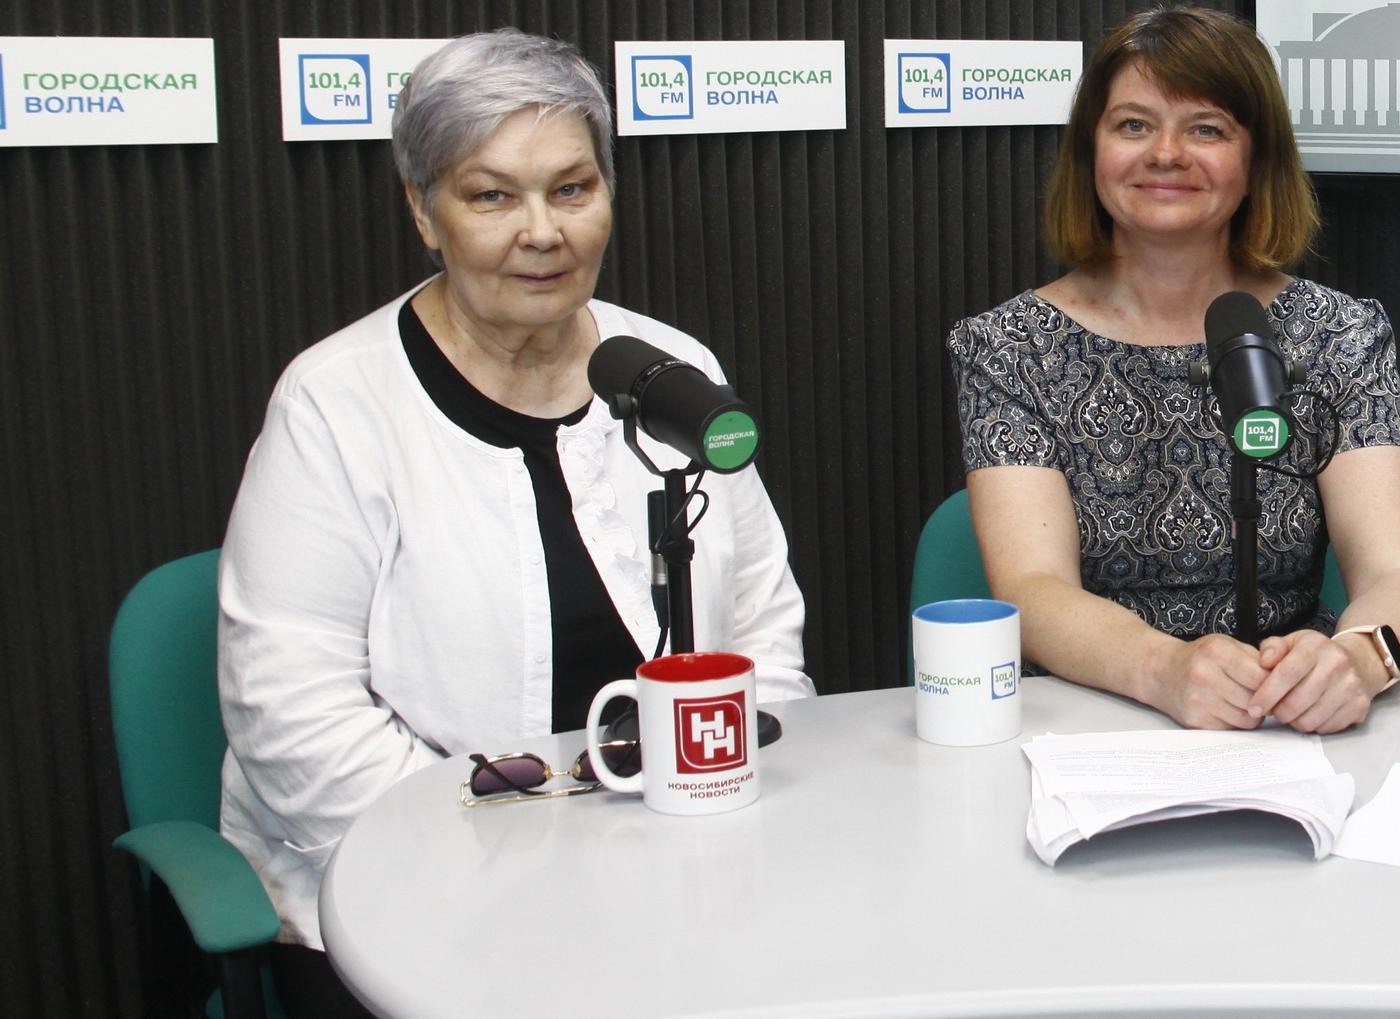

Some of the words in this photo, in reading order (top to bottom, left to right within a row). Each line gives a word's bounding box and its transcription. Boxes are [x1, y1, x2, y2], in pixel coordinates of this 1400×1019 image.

[23, 73, 197, 93] ГОРОДСКАЯ
[309, 72, 361, 91] 101,4
[640, 72, 685, 89] 101,4
[706, 70, 833, 87] ГОРОДСКАЯ
[905, 69, 944, 85] 101,4
[962, 68, 1072, 84] ГОРОДСКАЯ
[661, 92, 684, 104] FM
[706, 90, 779, 105] ВОЛНА
[922, 87, 943, 98] FM
[962, 87, 1025, 101] ВОЛНА
[25, 96, 125, 113] ВОЛНА
[333, 94, 360, 107] FM
[708, 430, 755, 442] ГОРОДСКАЯ
[708, 440, 735, 449] ВОЛНА
[919, 672, 981, 687] ГОРОДСКАЯ
[668, 771, 754, 790] НОВОСИБИРСКИЕ
[690, 786, 741, 799] НОВОСТИ
